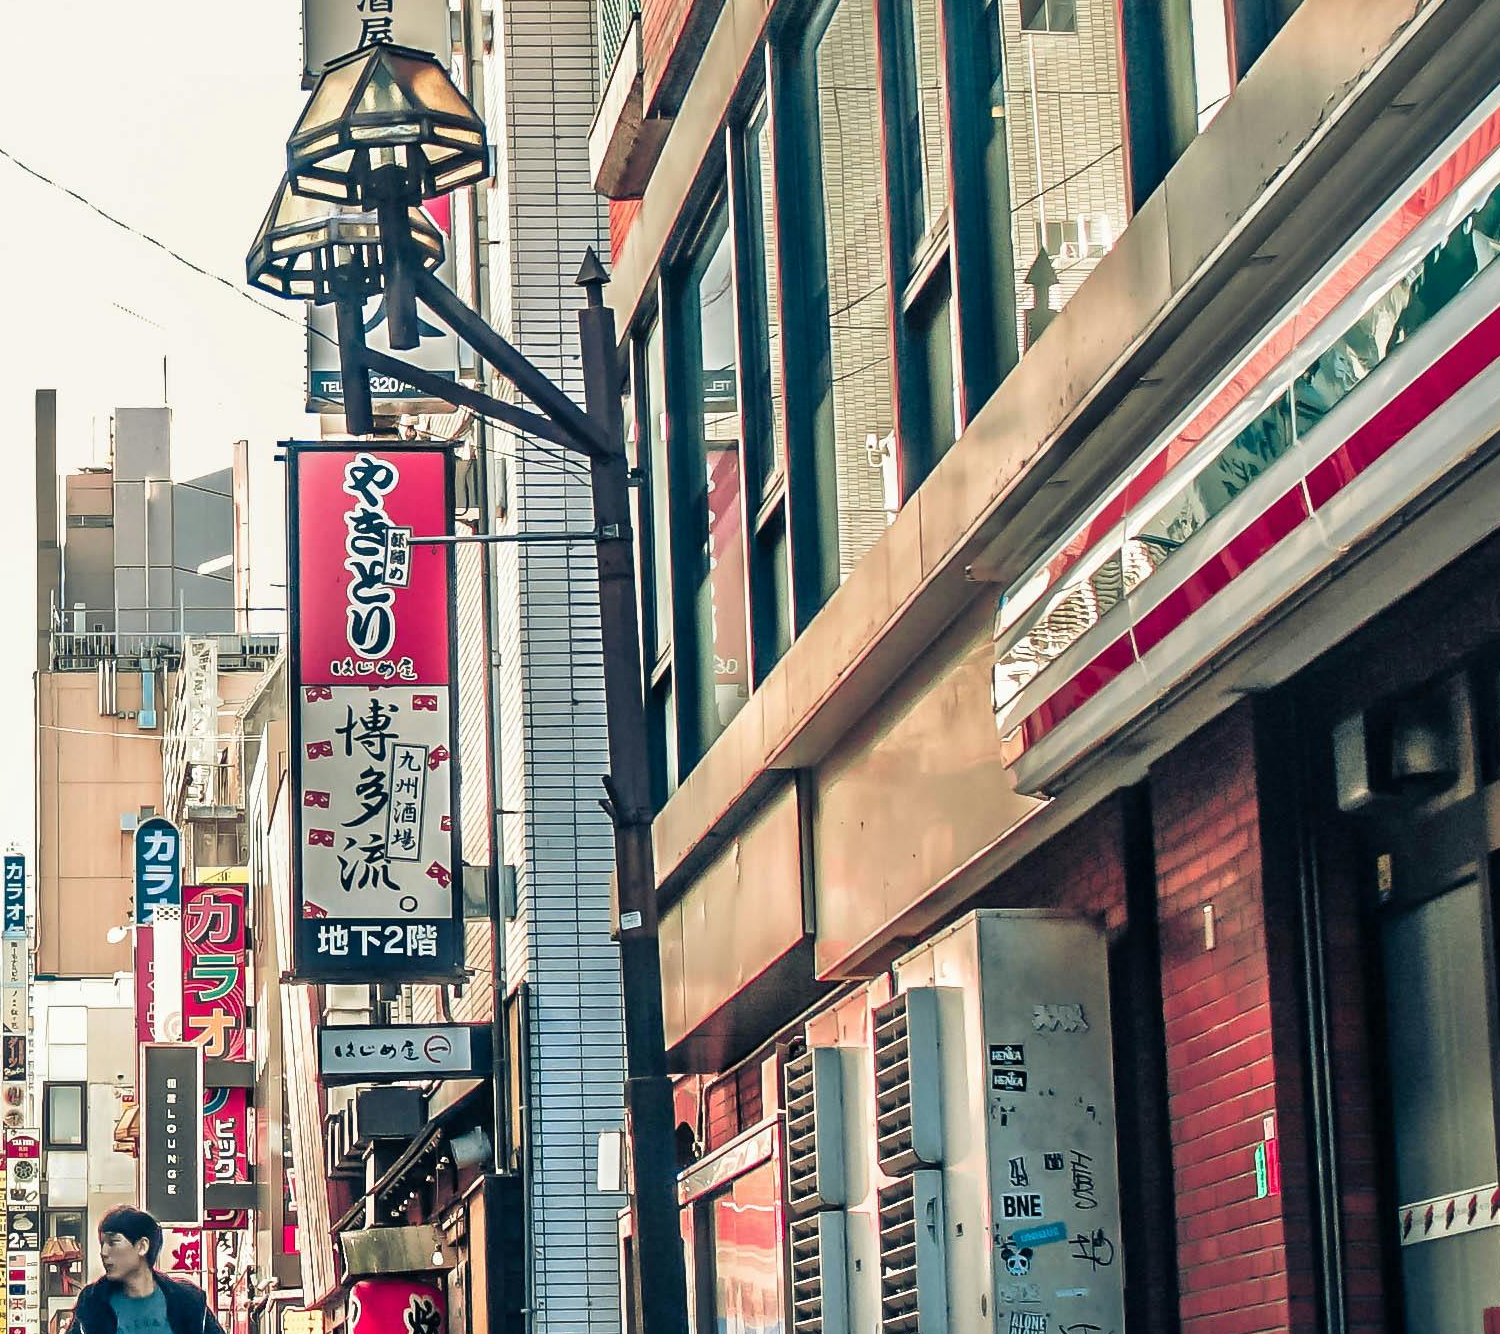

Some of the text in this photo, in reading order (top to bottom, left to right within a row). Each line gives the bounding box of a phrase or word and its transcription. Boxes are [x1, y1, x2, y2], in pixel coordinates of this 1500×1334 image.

[392, 749, 422, 851] 九州酒場
[318, 923, 437, 958] 地下2階
[1003, 1194, 1042, 1217] BNE
[1011, 1312, 1046, 1329] ALONE
